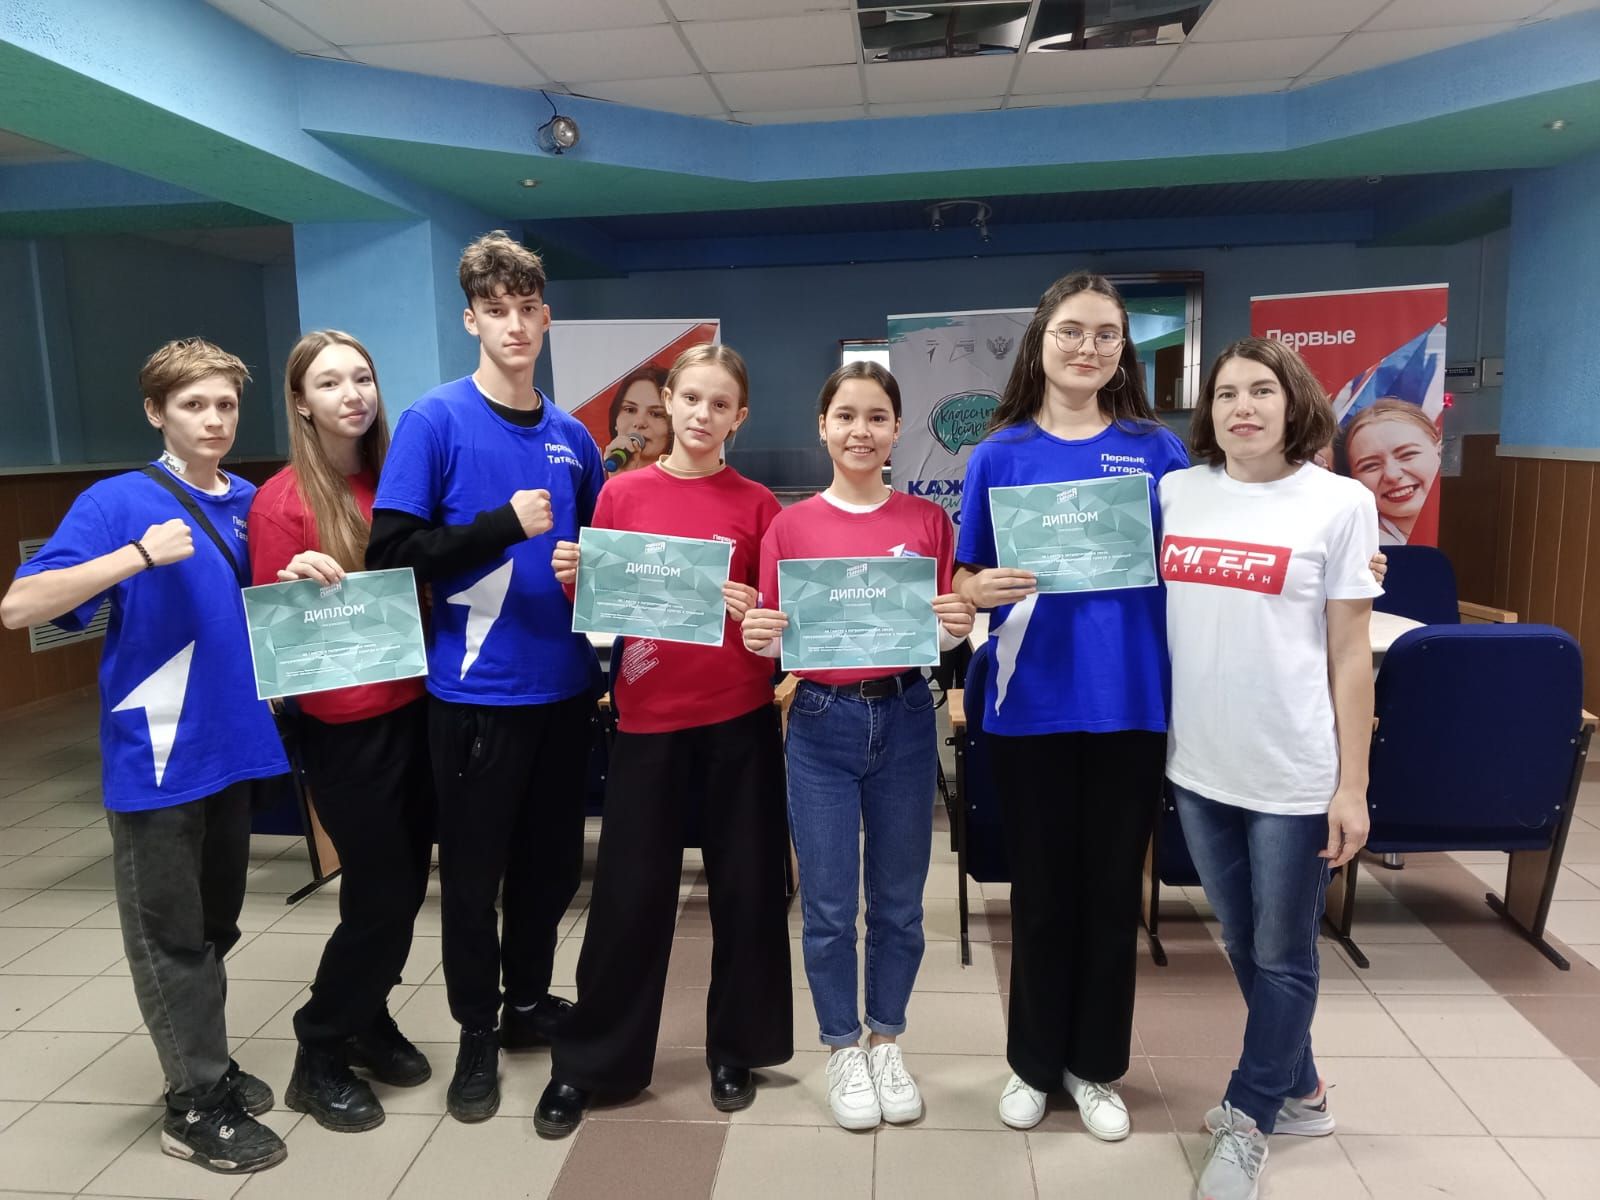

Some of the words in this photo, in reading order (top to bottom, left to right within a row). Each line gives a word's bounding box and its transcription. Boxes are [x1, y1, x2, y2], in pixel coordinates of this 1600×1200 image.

[1266, 329, 1356, 352] Первые
[1101, 453, 1145, 464] Первые
[908, 480, 965, 496] КАЖ
[1042, 511, 1099, 527] ДИПЛОМ
[1164, 543, 1277, 571] МГЕР
[625, 562, 681, 577] ДИПЛОМ
[1163, 563, 1271, 585] ТАТАРСТАН
[829, 586, 887, 602] ДИПЛОМ
[303, 604, 365, 623] ДИПЛОМ
